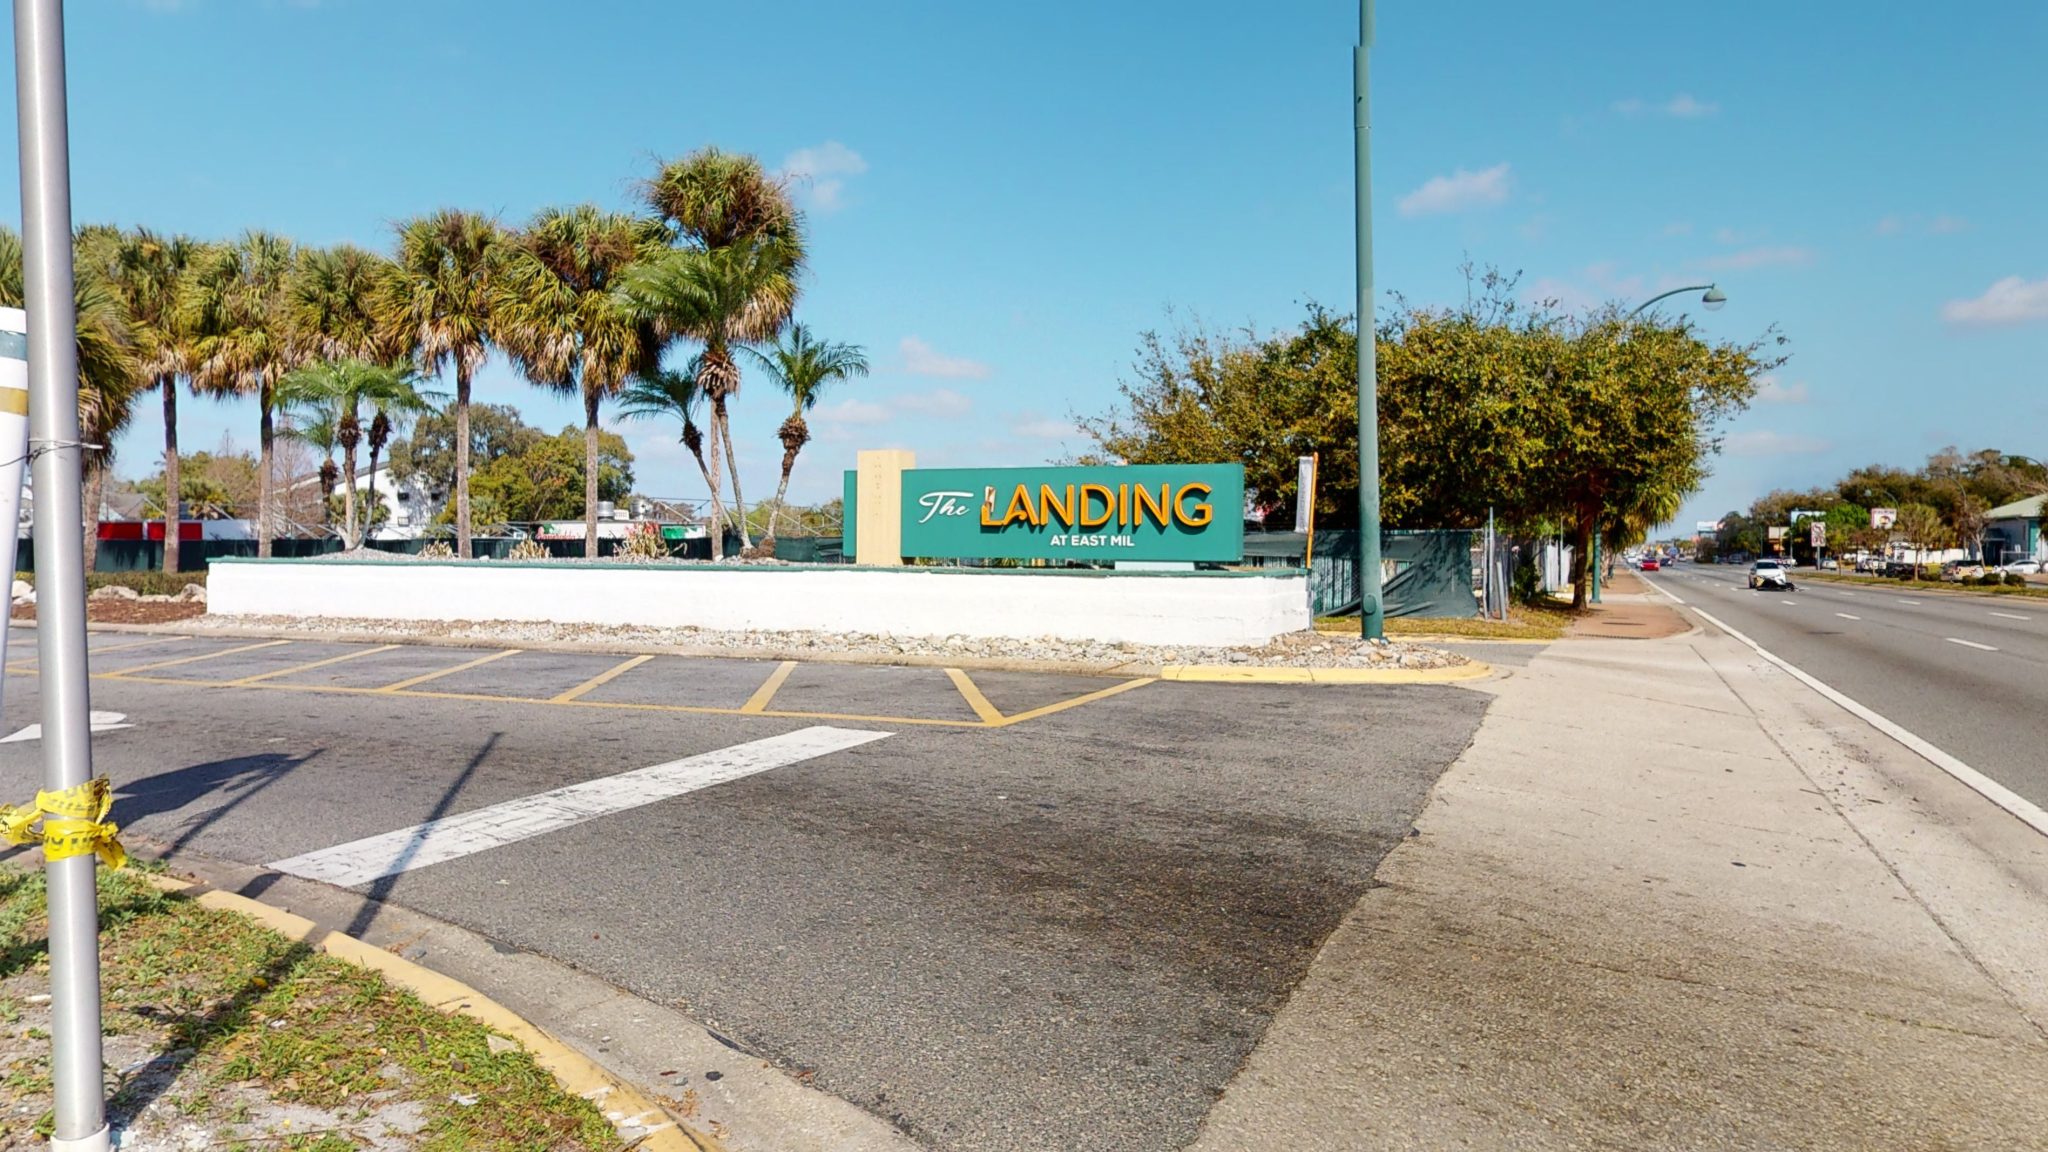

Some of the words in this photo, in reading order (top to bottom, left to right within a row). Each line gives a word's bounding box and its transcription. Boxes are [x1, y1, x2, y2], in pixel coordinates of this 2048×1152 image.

[918, 491, 974, 524] The
[980, 482, 1213, 526] LANDING
[1050, 535, 1069, 547] AT
[1071, 535, 1107, 547] EAST
[1110, 535, 1135, 547] MIL
